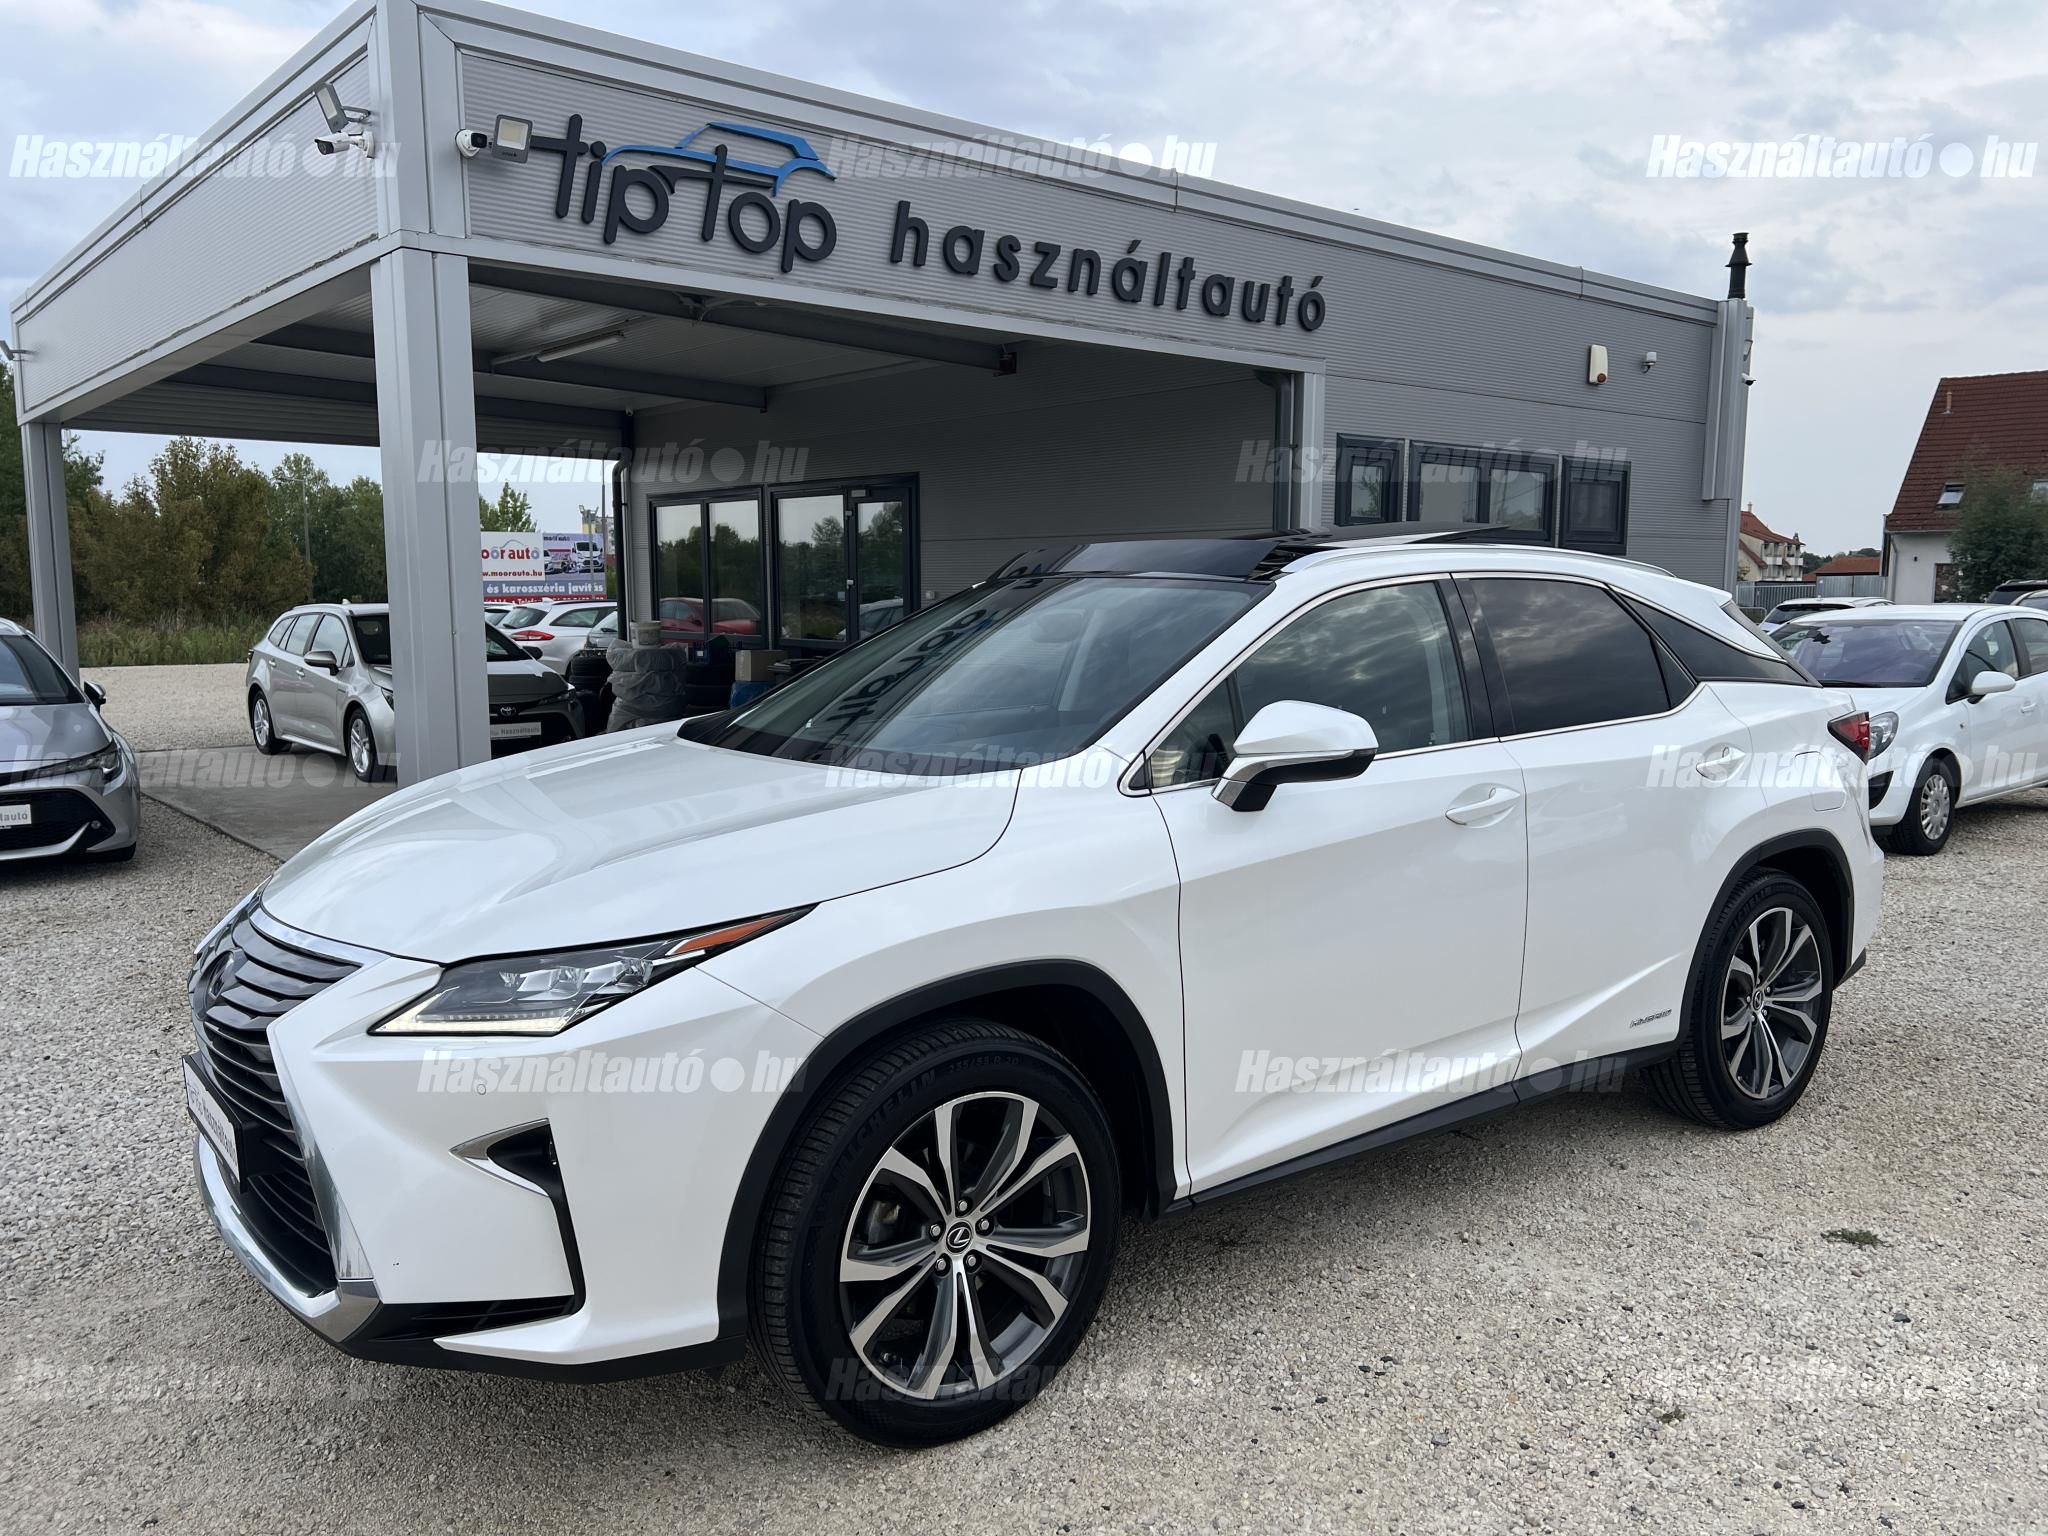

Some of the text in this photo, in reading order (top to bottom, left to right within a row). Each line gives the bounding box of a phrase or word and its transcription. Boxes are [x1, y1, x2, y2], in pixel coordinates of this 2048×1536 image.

[530, 113, 670, 244] tip
[890, 199, 1326, 331] használtautó
[486, 583, 499, 593] és
[502, 583, 565, 593] karosszéria
